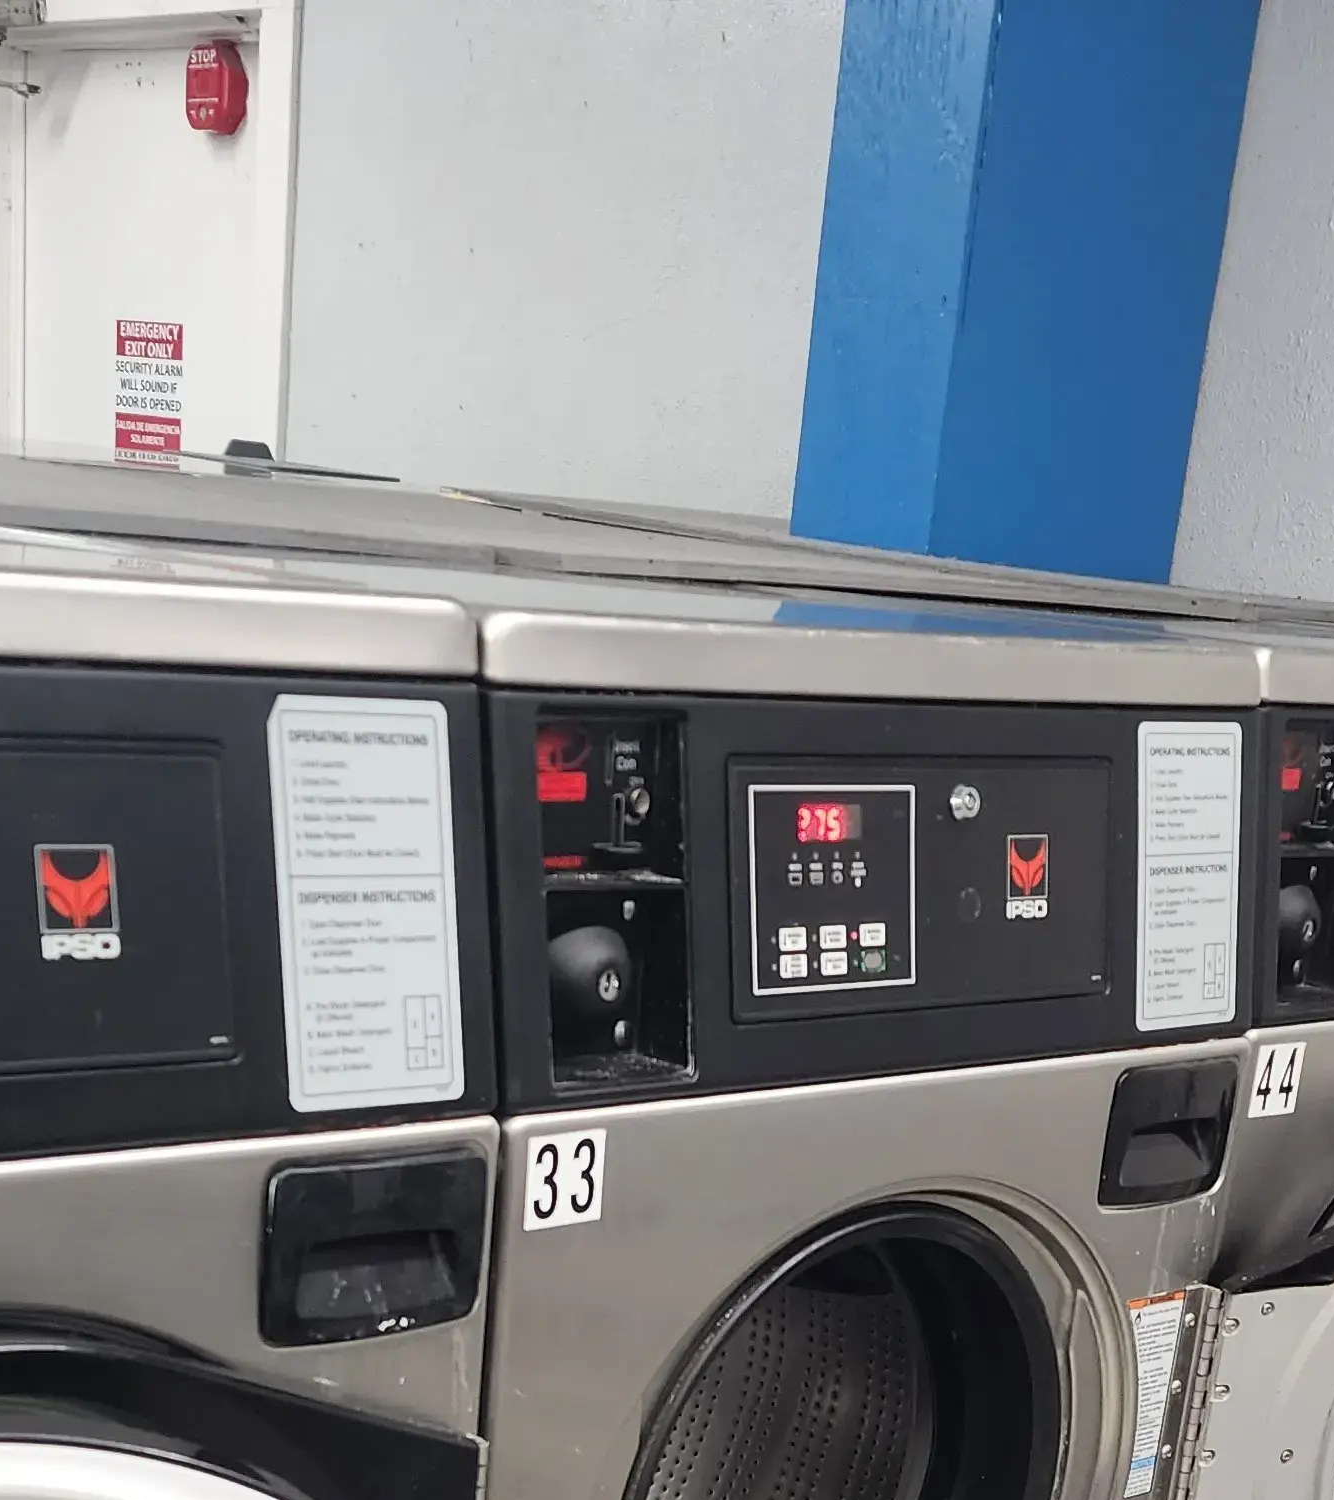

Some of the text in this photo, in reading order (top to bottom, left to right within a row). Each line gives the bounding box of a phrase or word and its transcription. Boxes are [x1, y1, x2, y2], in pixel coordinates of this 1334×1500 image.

[190, 49, 217, 63] STOP
[120, 321, 180, 342] EMERGENCY
[124, 340, 174, 358] EXIT ONLY
[115, 360, 183, 377] SECURITY ALARM
[120, 377, 178, 394] WILL SOUND IF
[115, 394, 182, 413] DOOR IS OPENED
[1006, 899, 1048, 919] IPSO
[1256, 1047, 1297, 1110] 44
[534, 1138, 595, 1219] 33
